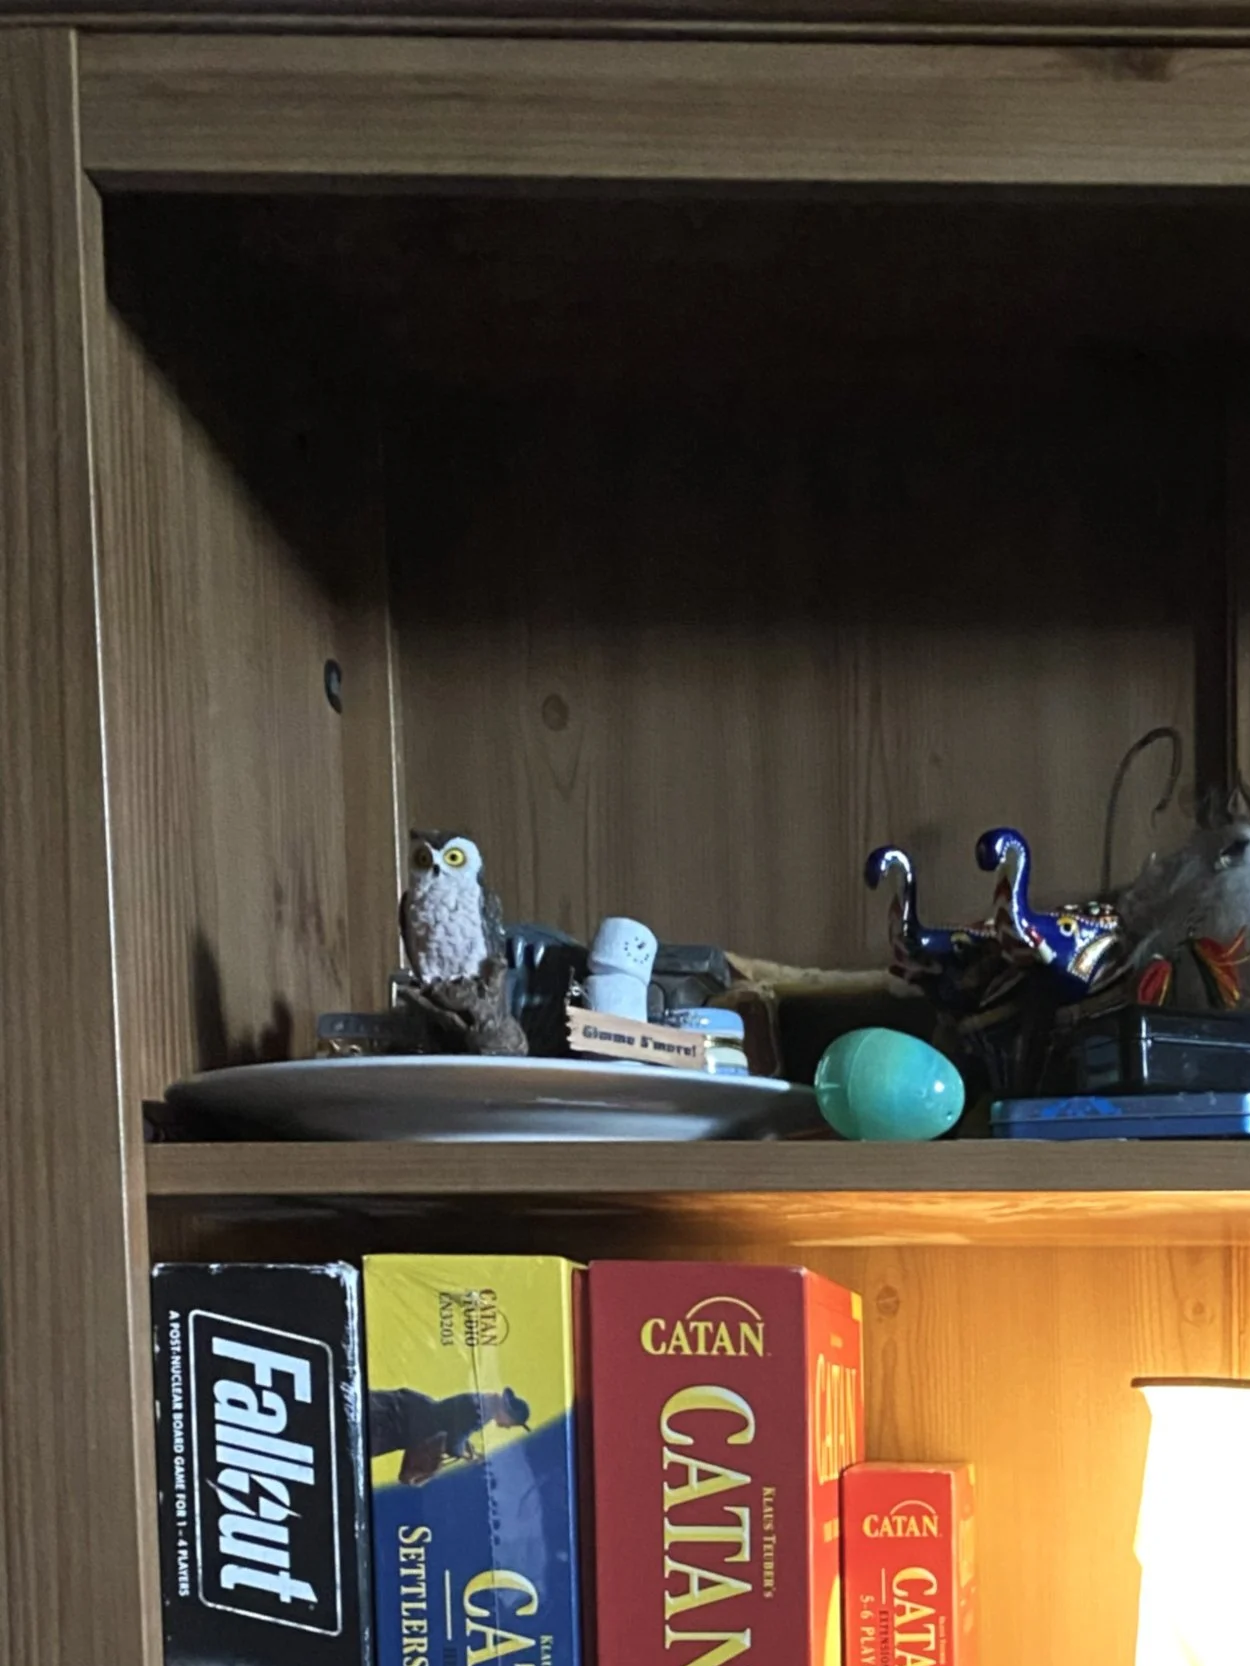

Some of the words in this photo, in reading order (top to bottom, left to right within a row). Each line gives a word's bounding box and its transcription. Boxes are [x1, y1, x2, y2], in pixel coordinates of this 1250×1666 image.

[168, 1309, 181, 1320] A
[640, 1317, 766, 1358] CATAN
[168, 1322, 184, 1411] POST-NUCLEAR
[171, 1413, 185, 1454] BOARD
[815, 1353, 857, 1486] CATAN
[173, 1456, 187, 1494] GAME
[207, 1335, 318, 1604] Fallout
[175, 1496, 187, 1518] FOR
[862, 1514, 939, 1539] CATAN
[177, 1551, 190, 1598] PLAYERS
[860, 1594, 875, 1620] 5-6
